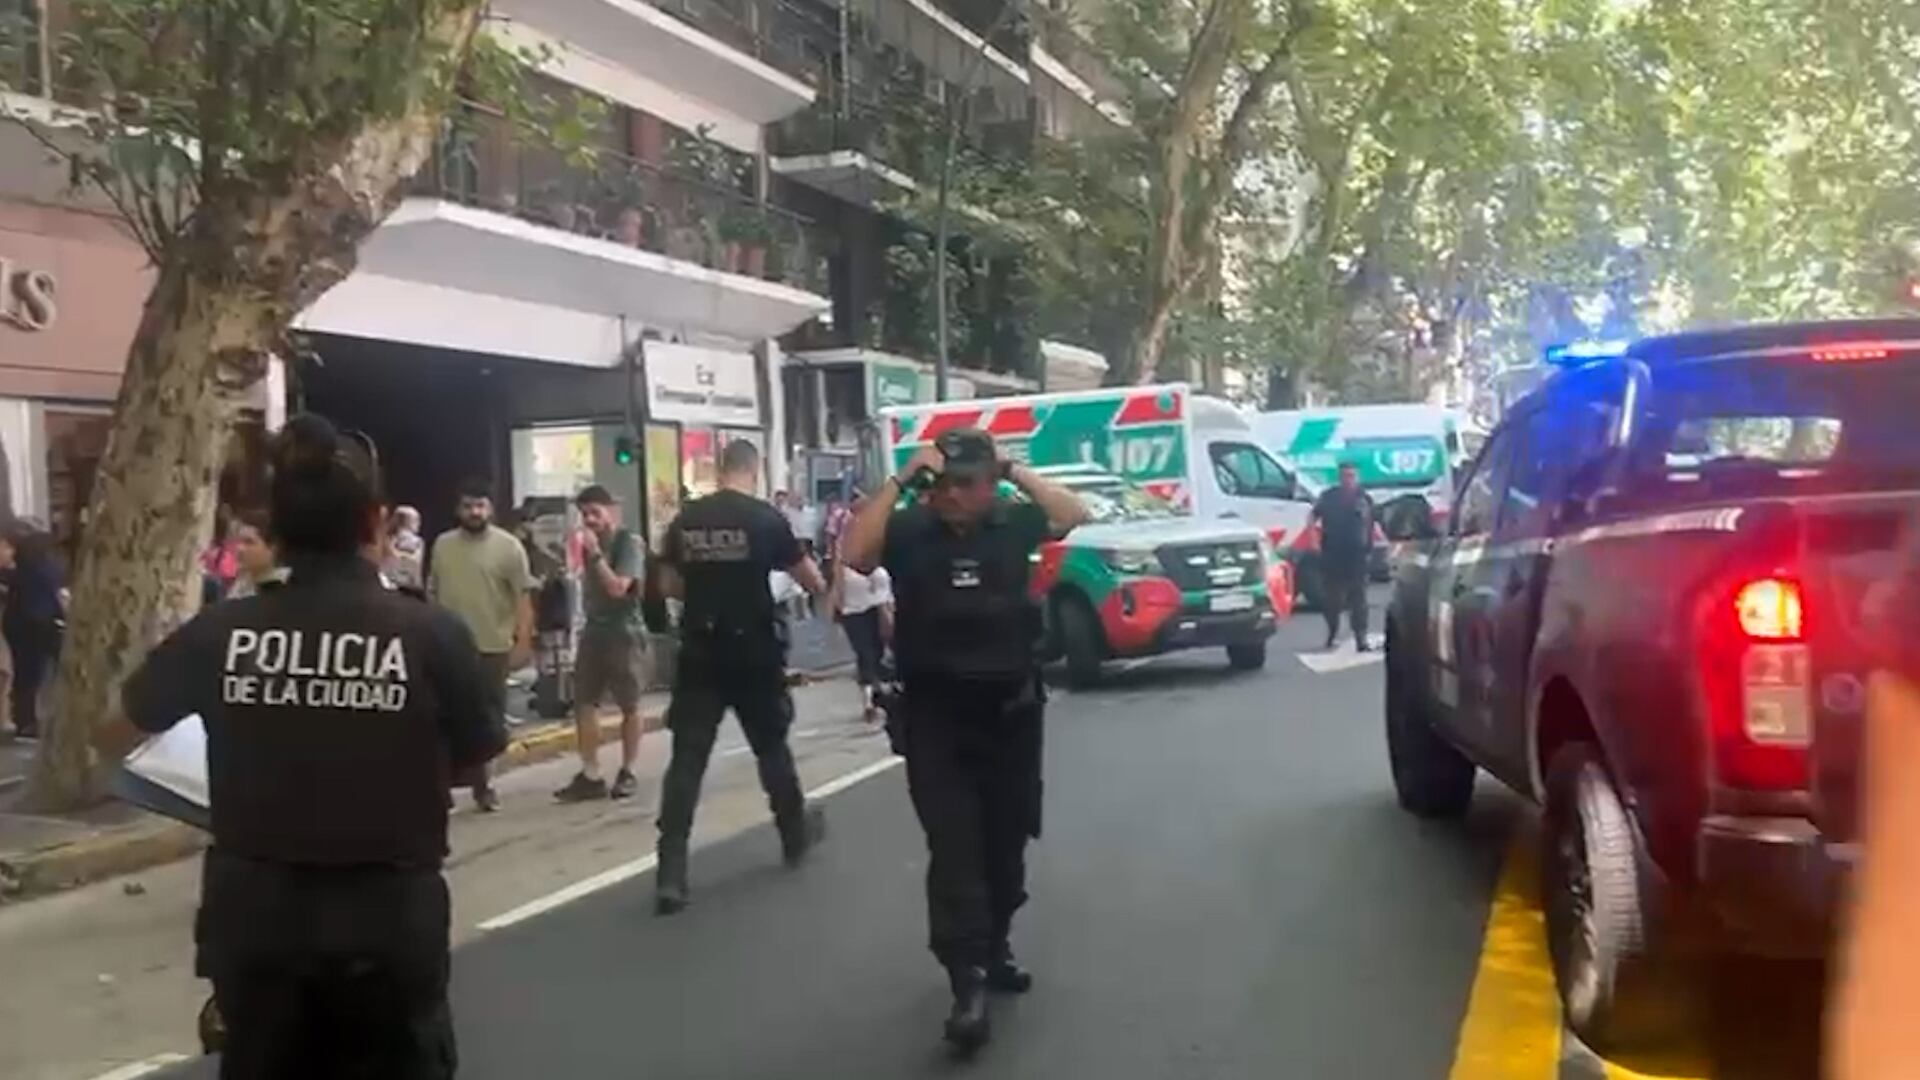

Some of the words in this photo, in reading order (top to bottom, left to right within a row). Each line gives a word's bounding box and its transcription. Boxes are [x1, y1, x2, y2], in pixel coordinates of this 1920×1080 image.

[1109, 437, 1175, 473] 107
[1390, 449, 1436, 475] 107
[225, 628, 408, 682] POLICIA
[223, 673, 260, 705] DE
[263, 676, 300, 705] LA
[306, 678, 407, 712] CIUDAD
